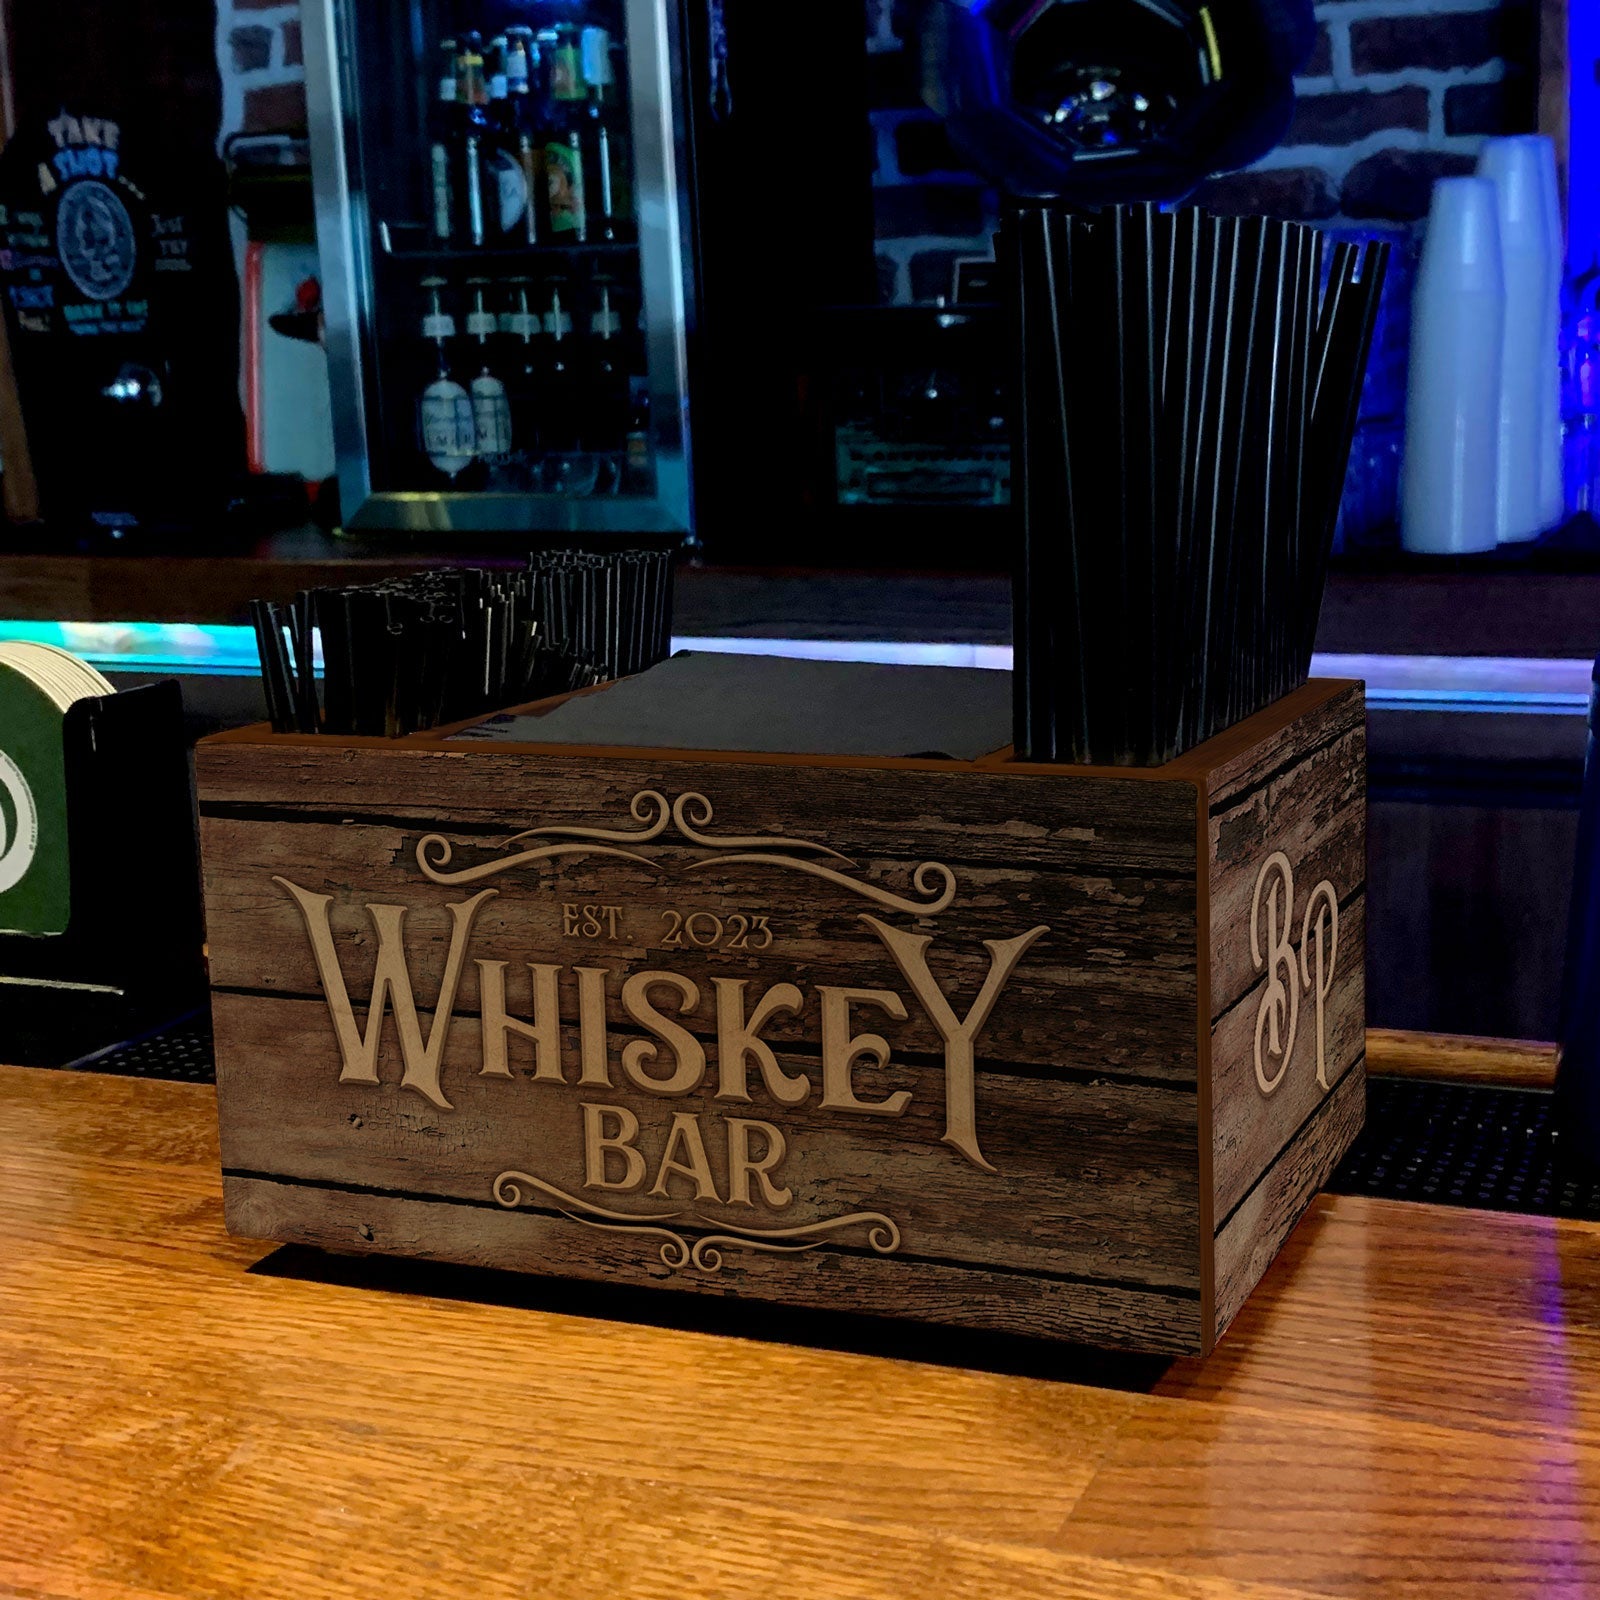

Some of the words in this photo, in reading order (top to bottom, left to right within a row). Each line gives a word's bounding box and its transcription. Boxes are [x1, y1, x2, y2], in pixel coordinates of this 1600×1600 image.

[562, 900, 635, 943] EST.
[660, 909, 775, 952] 2023
[271, 875, 1052, 1174] WHISKEY
[580, 1101, 794, 1210] BAR
